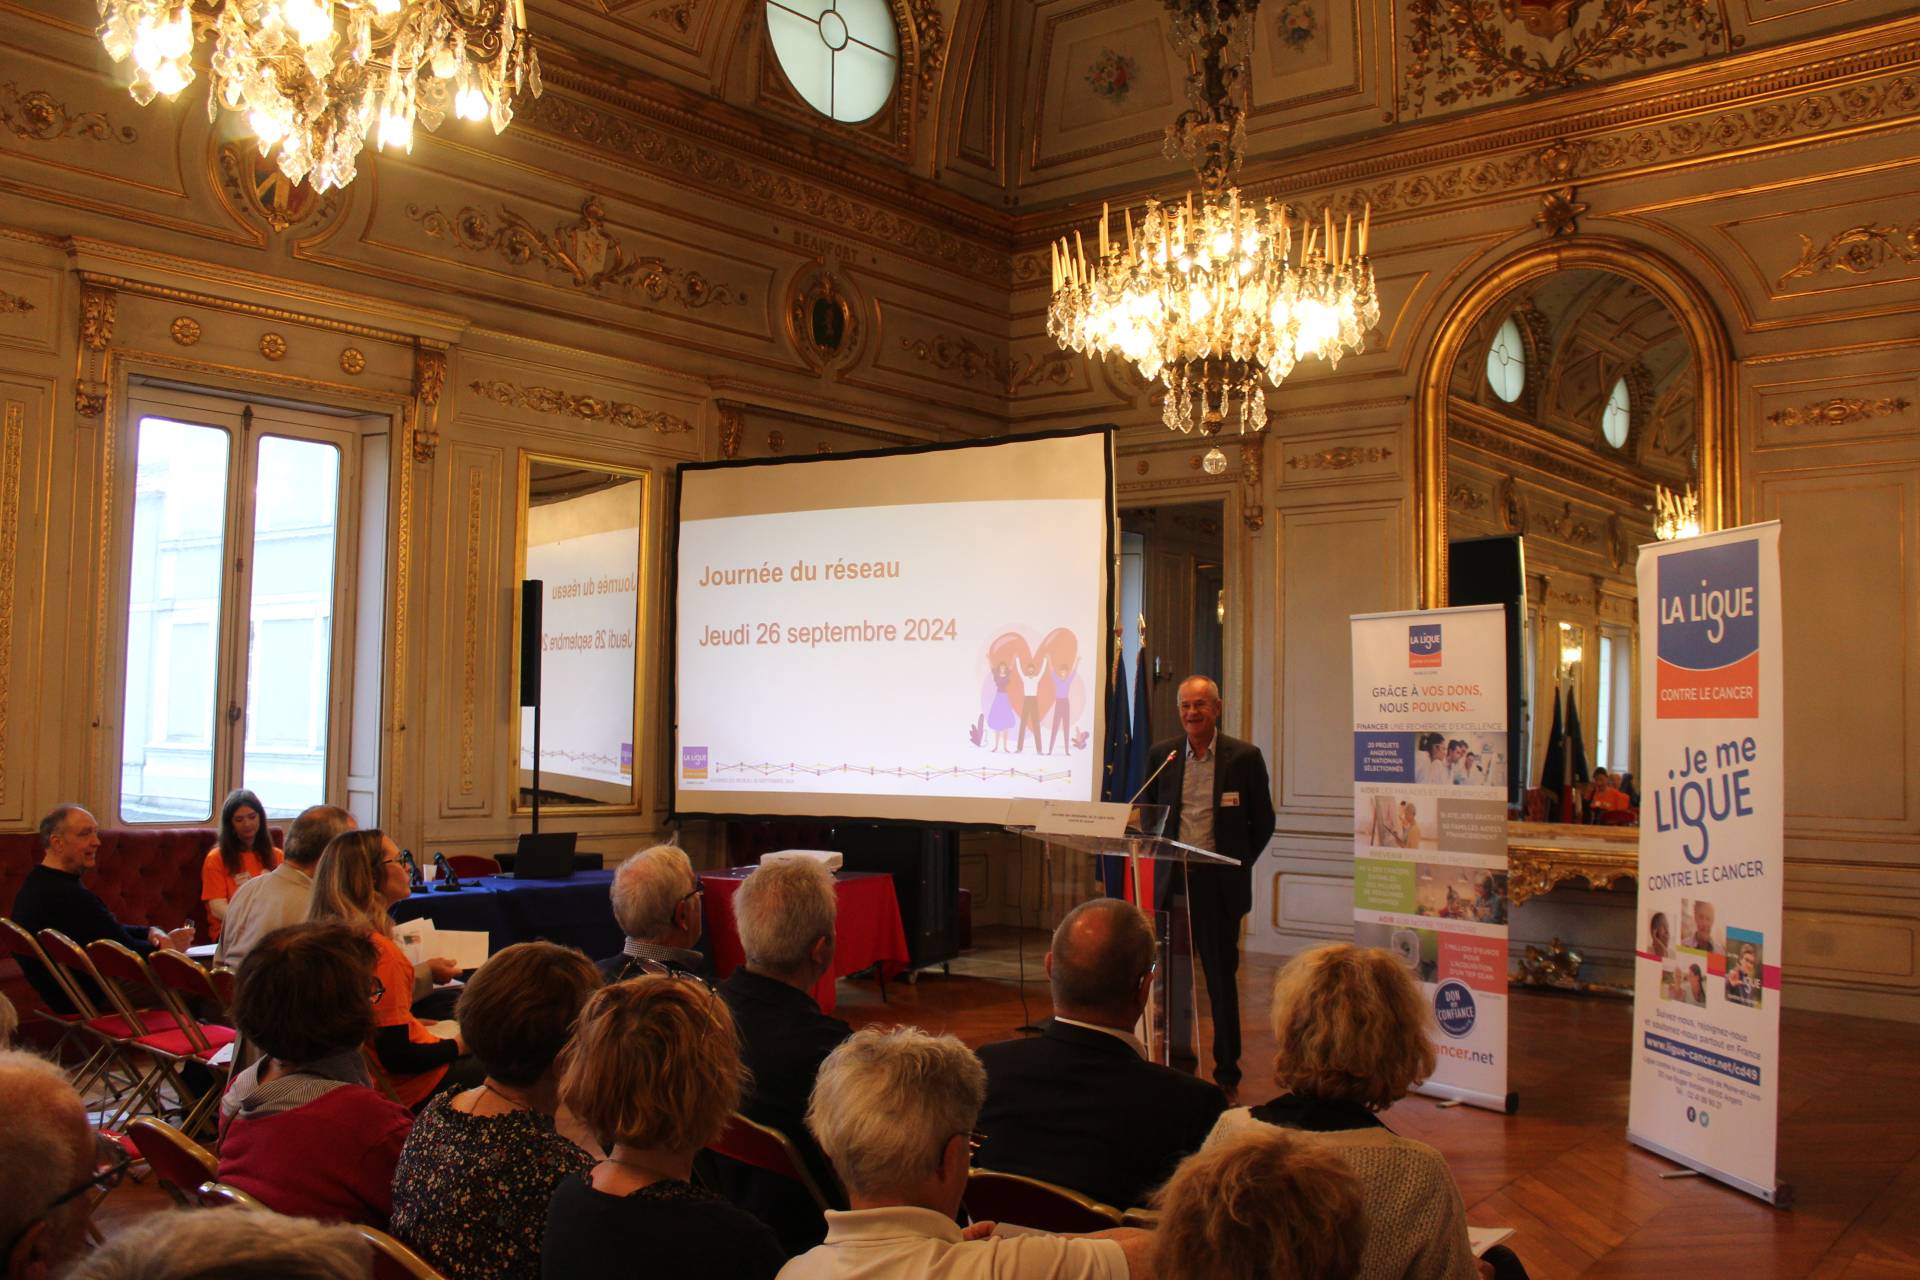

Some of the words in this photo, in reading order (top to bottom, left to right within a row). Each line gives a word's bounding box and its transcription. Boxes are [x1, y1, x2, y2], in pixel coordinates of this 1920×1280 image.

[793, 230, 859, 262] BEAUFORT
[699, 562, 783, 587] Journée
[790, 560, 817, 582] du
[825, 558, 900, 580] réseau
[1661, 596, 1685, 625] LA
[699, 624, 750, 647] Jeudi
[756, 622, 781, 645] 26
[787, 620, 897, 648] septembre
[903, 618, 958, 642] 2024
[1410, 635, 1419, 645] LA
[1372, 685, 1408, 698] GRÂCE
[1411, 684, 1419, 696] À
[1421, 686, 1444, 697] VOS
[1447, 685, 1483, 697] DONS,
[1661, 688, 1697, 701] CONTRE
[1700, 687, 1711, 700] LE
[1712, 686, 1753, 701] CANCER
[1379, 702, 1409, 713] NOUS
[1680, 746, 1707, 778] Je
[1716, 736, 1756, 769] me
[1648, 871, 1693, 891] CONTRE
[1695, 868, 1710, 885] LE
[1712, 860, 1764, 882] CANCER
[1445, 991, 1460, 1002] DON
[1438, 1007, 1473, 1020] CONFIANCE
